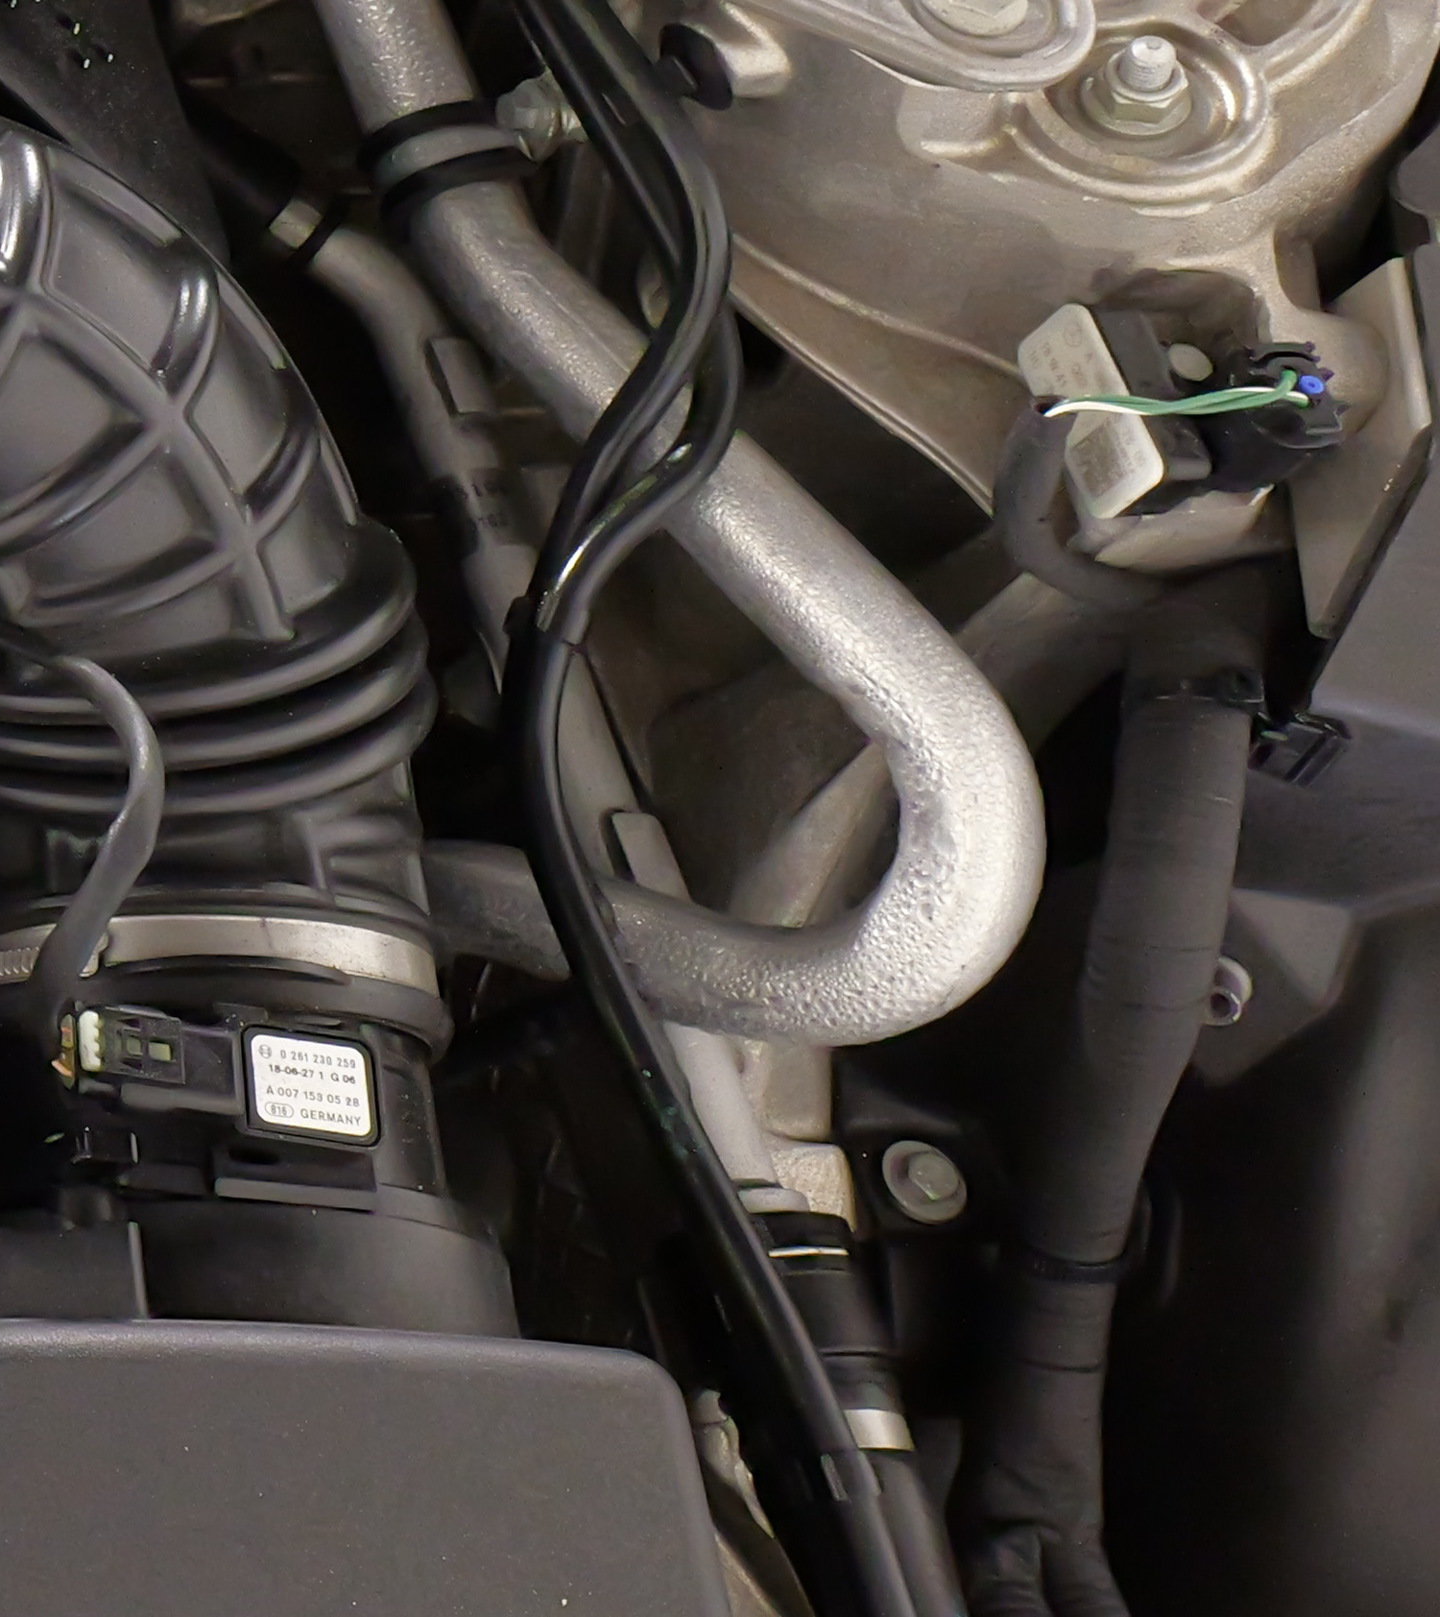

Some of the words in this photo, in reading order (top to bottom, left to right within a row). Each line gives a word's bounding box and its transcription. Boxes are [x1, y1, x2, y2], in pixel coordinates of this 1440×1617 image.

[280, 1050, 286, 1059] 0
[313, 1054, 332, 1065] 230
[337, 1058, 356, 1069] 259
[266, 1085, 274, 1095] A
[277, 1087, 299, 1098] 007
[303, 1091, 323, 1102] 153
[327, 1094, 341, 1104] 05
[345, 1097, 359, 1107] 28
[300, 1108, 361, 1125] GERMANY
